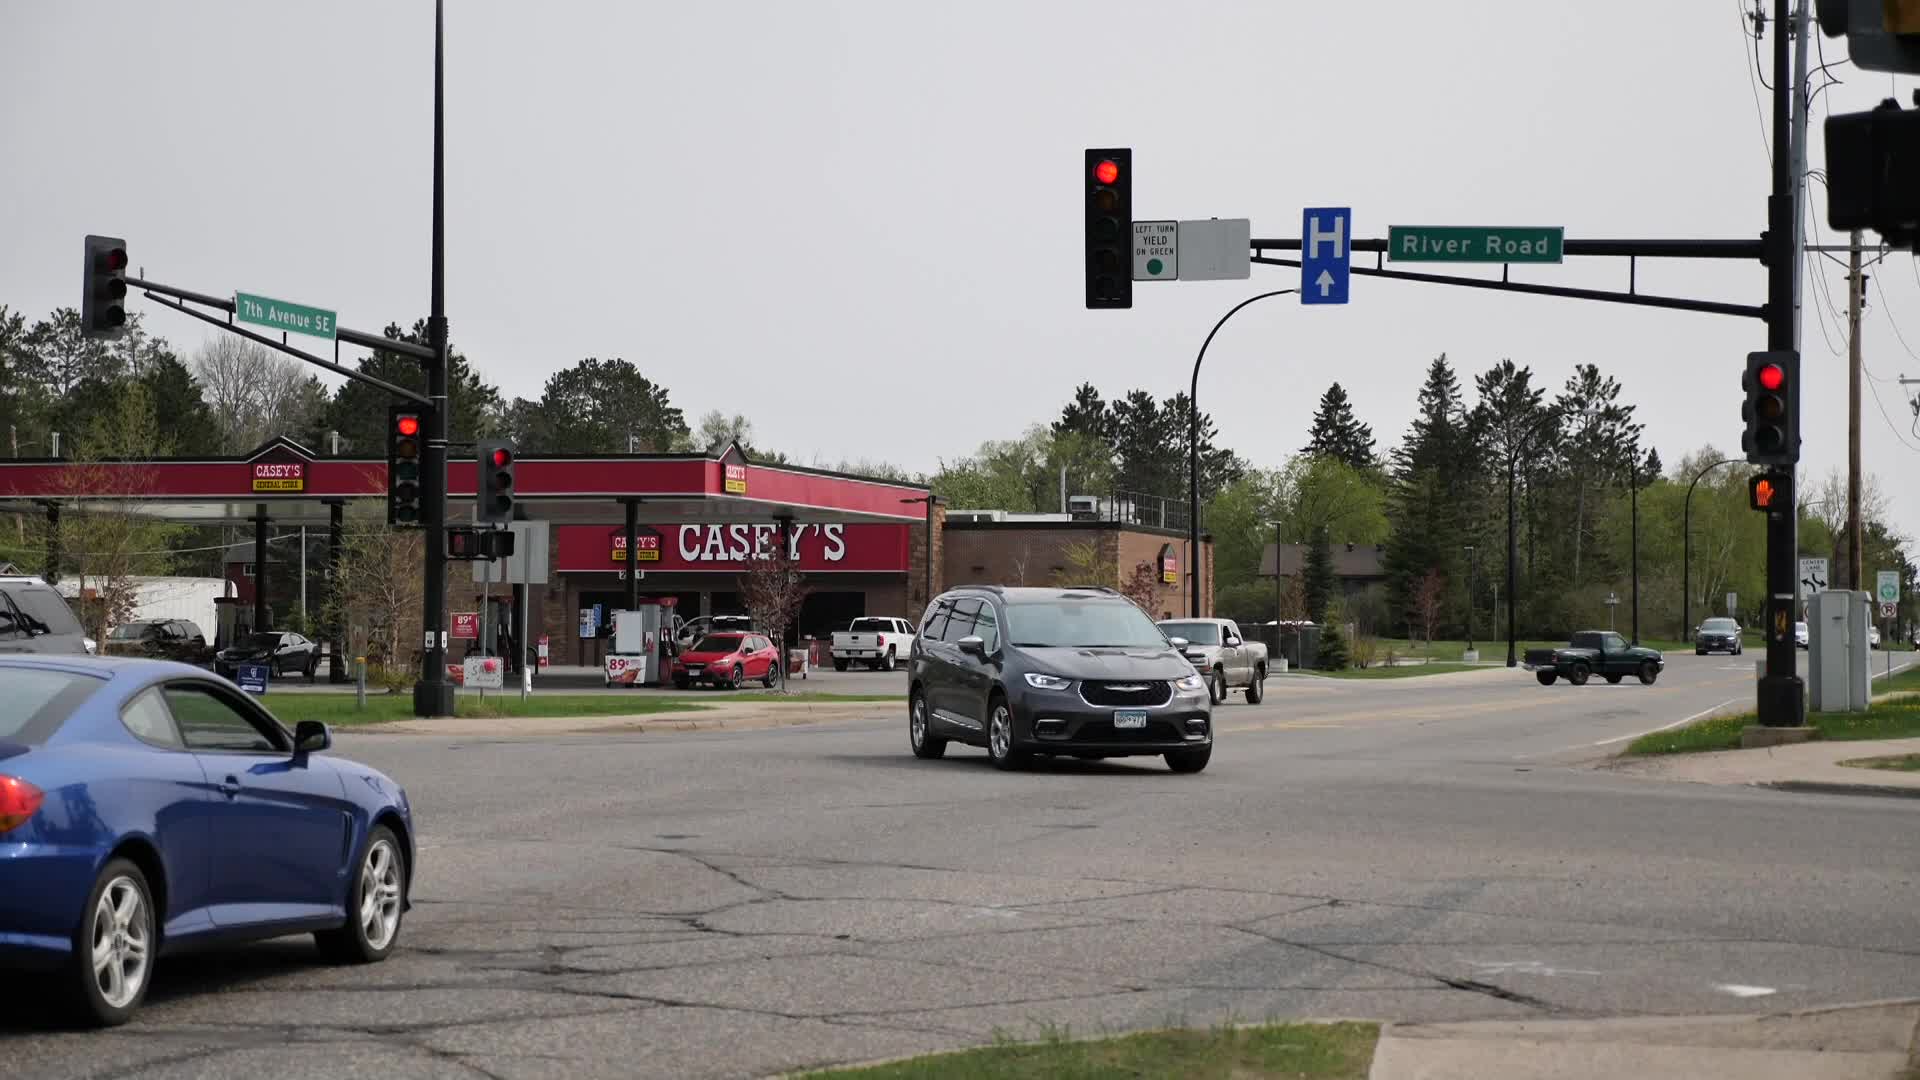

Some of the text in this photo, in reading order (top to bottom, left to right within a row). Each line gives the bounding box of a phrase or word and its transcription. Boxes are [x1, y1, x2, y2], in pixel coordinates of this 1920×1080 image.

[1135, 225, 1175, 234] LEFT TURN
[1143, 235, 1168, 246] YIELD
[1308, 216, 1344, 259] H
[1402, 235, 1549, 255] River Road
[1136, 247, 1174, 256] ON GREEN
[244, 301, 330, 333] 7th Avenue SE
[256, 465, 301, 477] CASEY'S
[614, 536, 656, 548] CAY'S
[678, 523, 846, 562] CASEY'S
